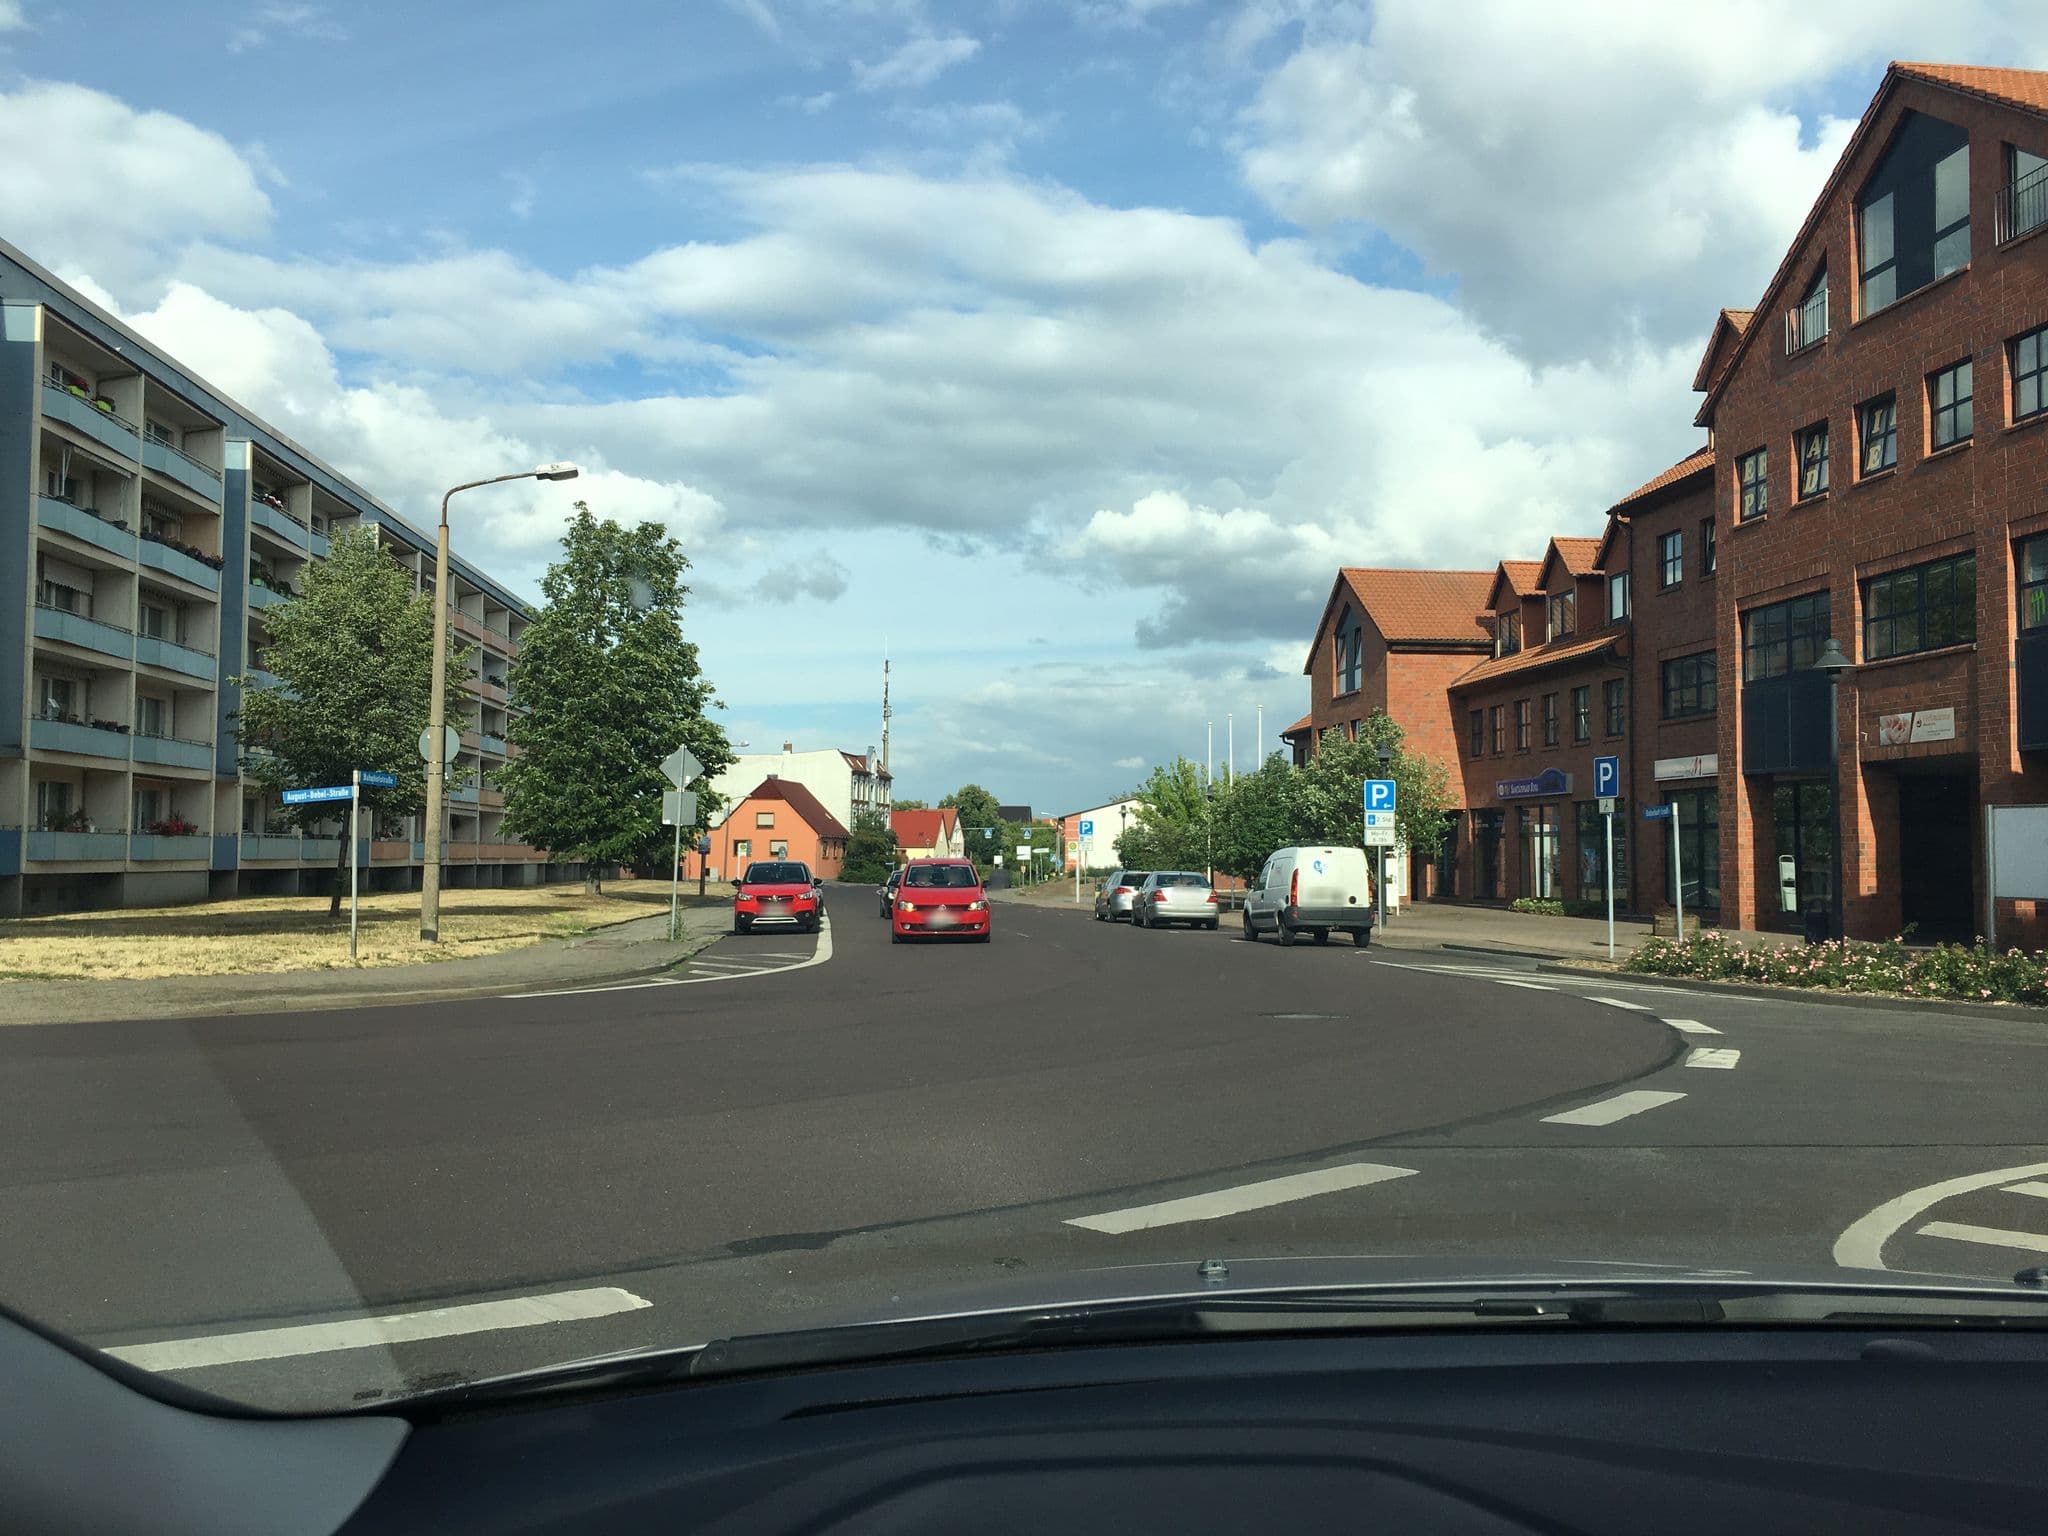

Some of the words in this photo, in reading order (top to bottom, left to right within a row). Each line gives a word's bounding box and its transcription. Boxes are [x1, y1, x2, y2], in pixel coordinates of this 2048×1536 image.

[1600, 762, 1612, 792] P
[286, 789, 349, 802] August-Bebel-Straße
[1372, 784, 1388, 807] P
[1082, 822, 1091, 834] P
